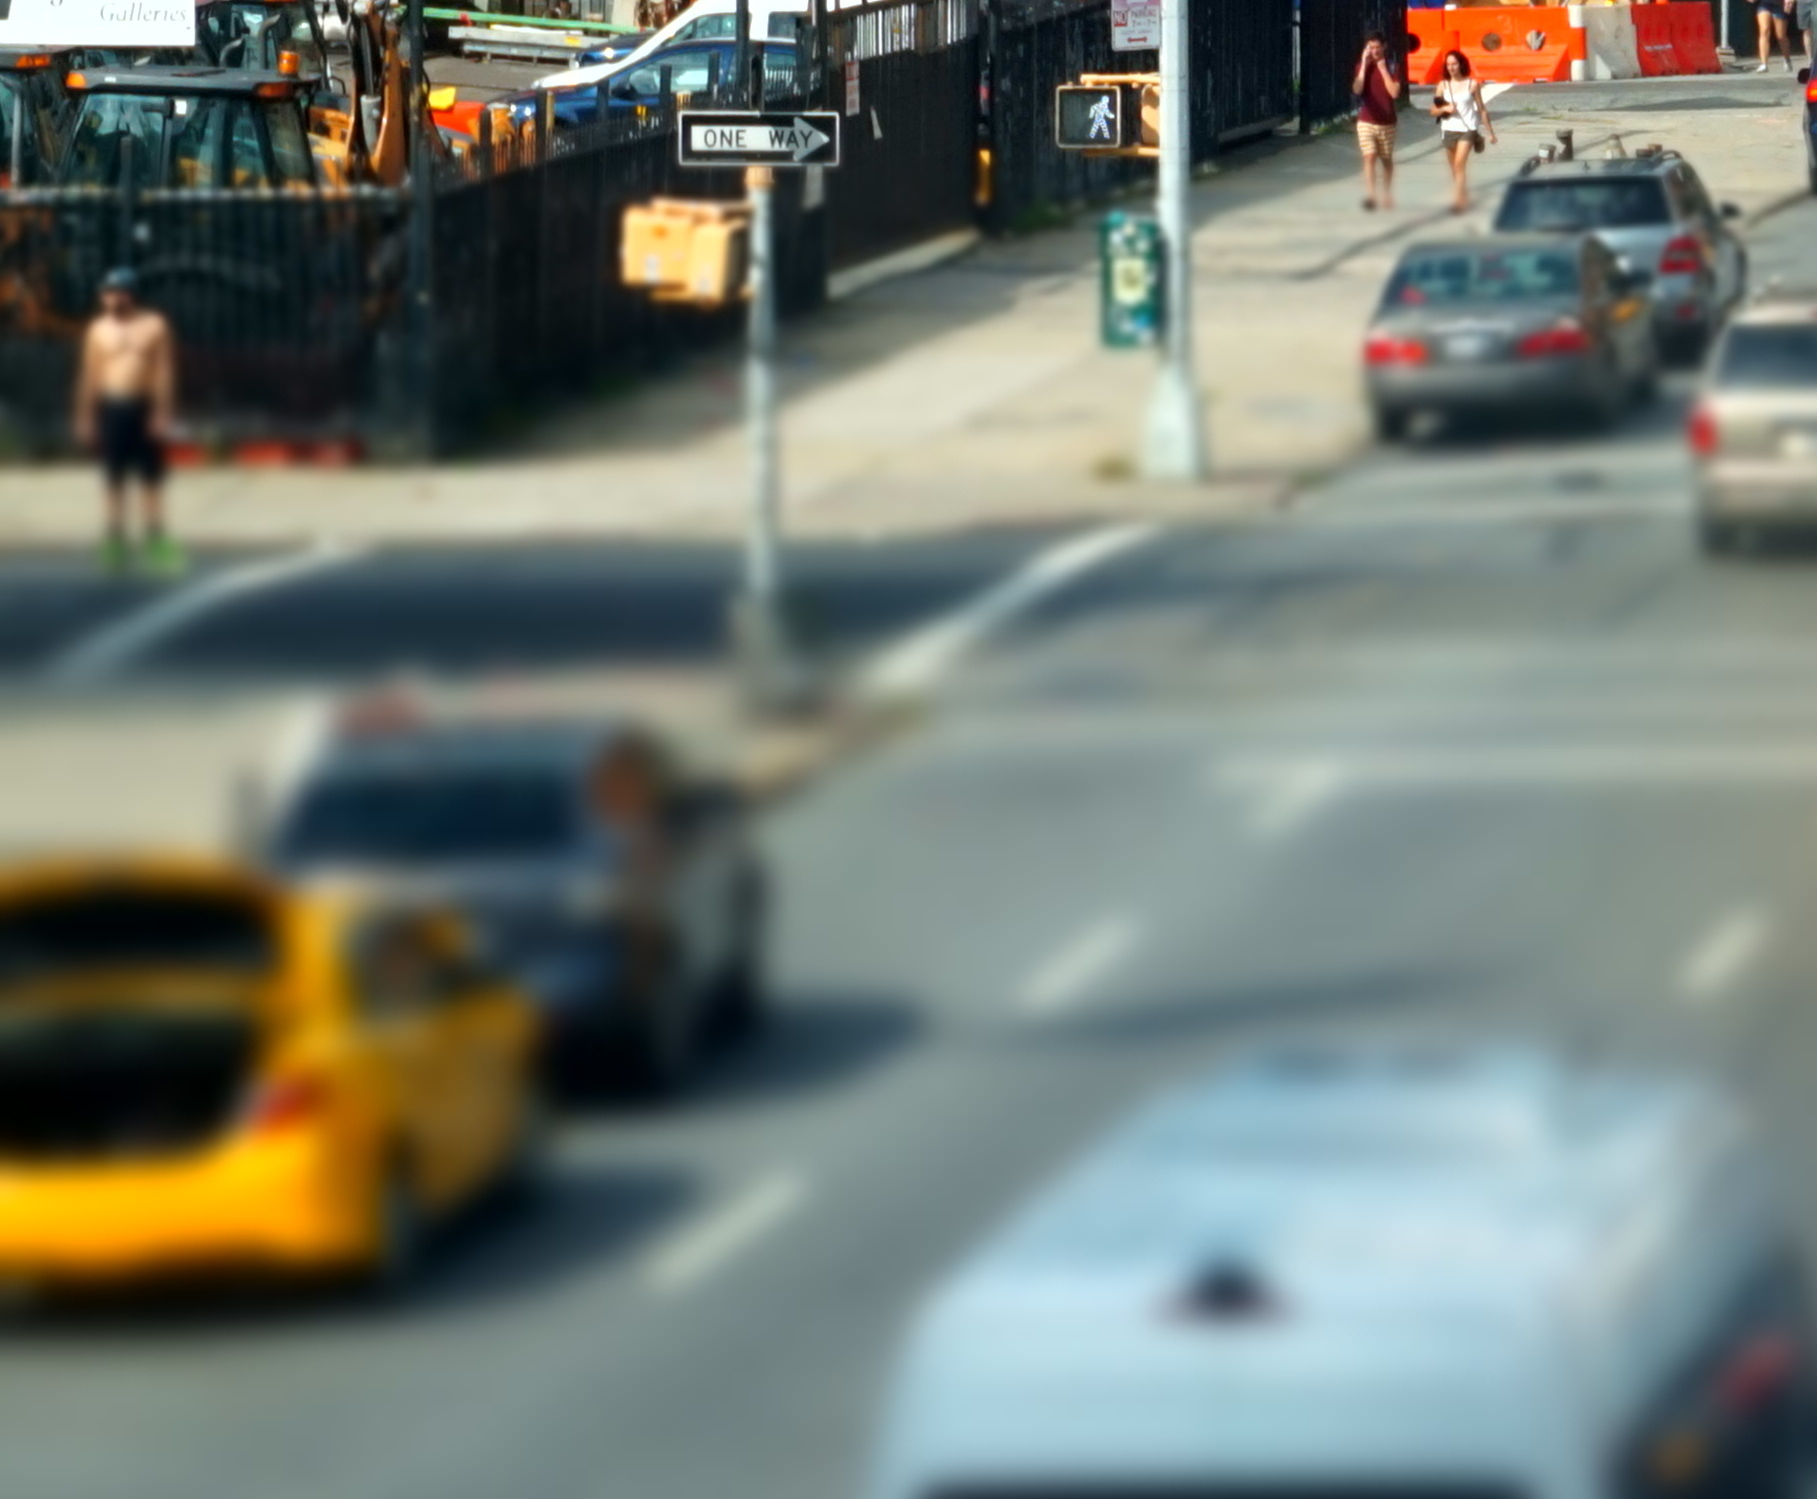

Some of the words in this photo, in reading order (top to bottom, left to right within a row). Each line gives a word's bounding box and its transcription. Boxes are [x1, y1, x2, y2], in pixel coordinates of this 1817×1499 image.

[100, 2, 187, 22] Galleries
[704, 129, 747, 148] ONE
[769, 129, 813, 148] WAY
